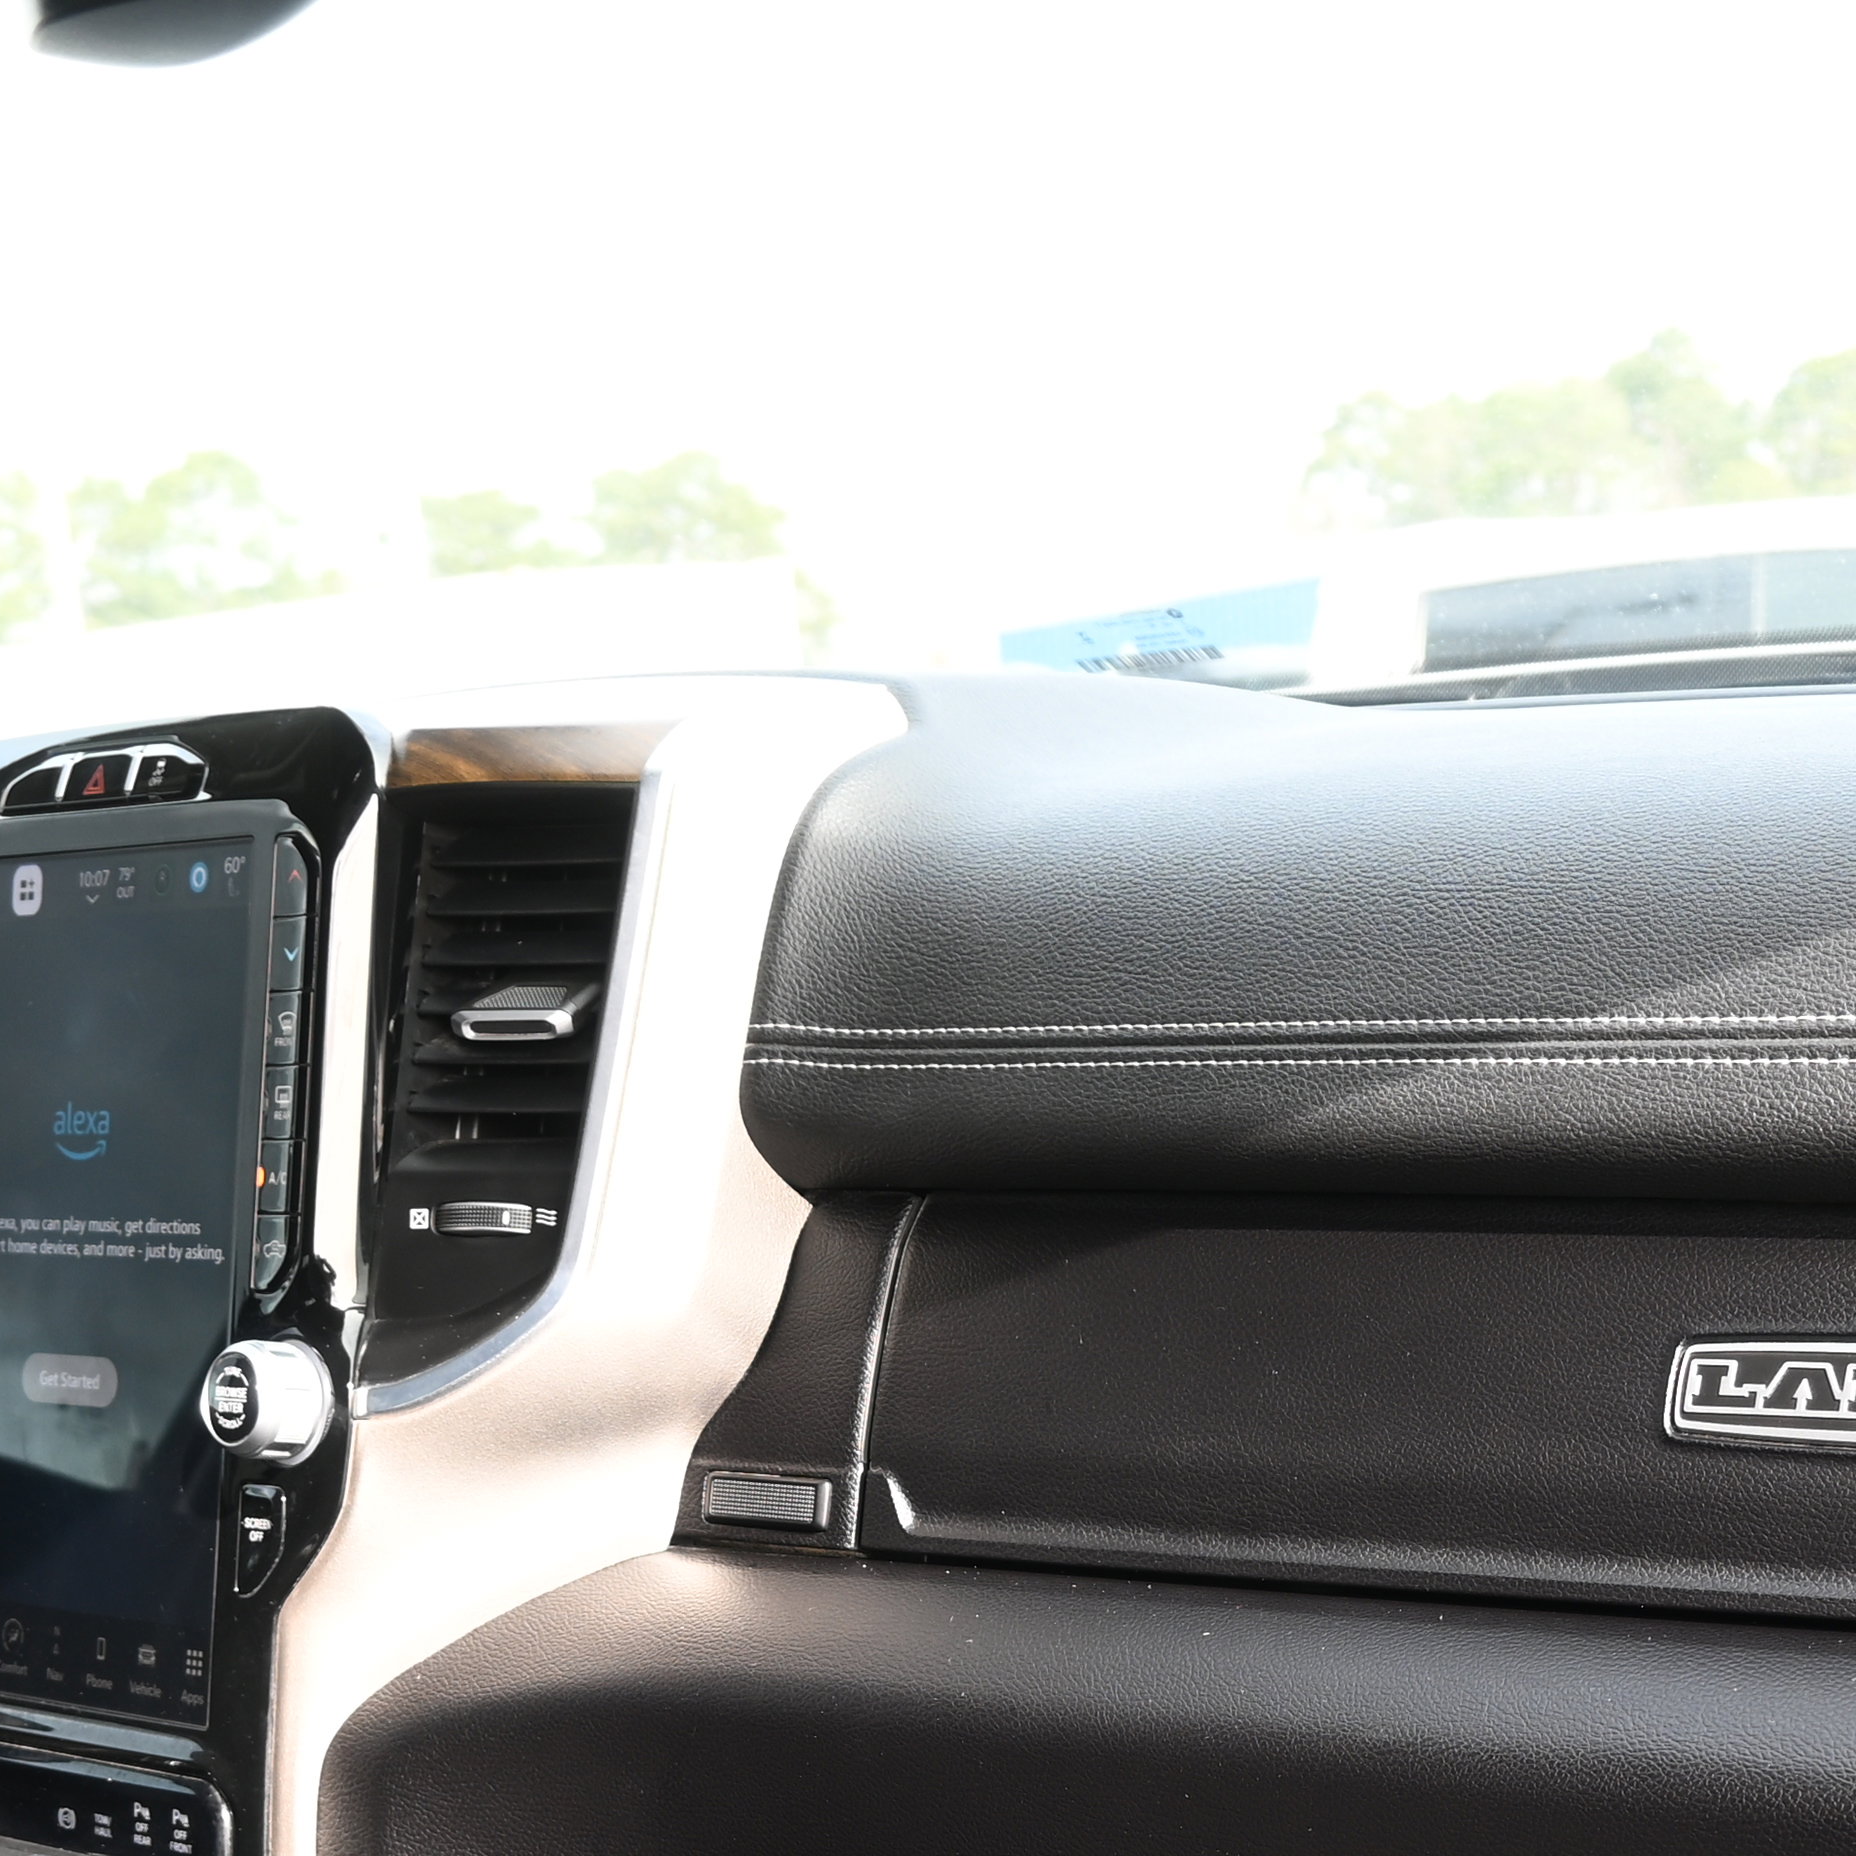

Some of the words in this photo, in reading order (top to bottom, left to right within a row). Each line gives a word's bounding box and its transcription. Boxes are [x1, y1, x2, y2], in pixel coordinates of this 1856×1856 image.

[79, 869, 110, 888] 10:07
[53, 1101, 111, 1135] alexa
[20, 1219, 40, 1234] you
[42, 1218, 61, 1231] can
[62, 1215, 86, 1236] play
[88, 1216, 122, 1235] music,
[124, 1218, 144, 1237] get
[145, 1217, 201, 1235] directions
[7, 1238, 38, 1253] home
[39, 1239, 81, 1258] devices,
[82, 1240, 104, 1256] and
[106, 1243, 136, 1258] more
[145, 1242, 167, 1261] just
[168, 1243, 183, 1263] by
[185, 1245, 225, 1265] asking.
[39, 1369, 59, 1387] Get
[60, 1371, 101, 1391] Started
[249, 1530, 265, 1543] OFF
[85, 1673, 113, 1691] Phone
[128, 1679, 162, 1699] Vehicle
